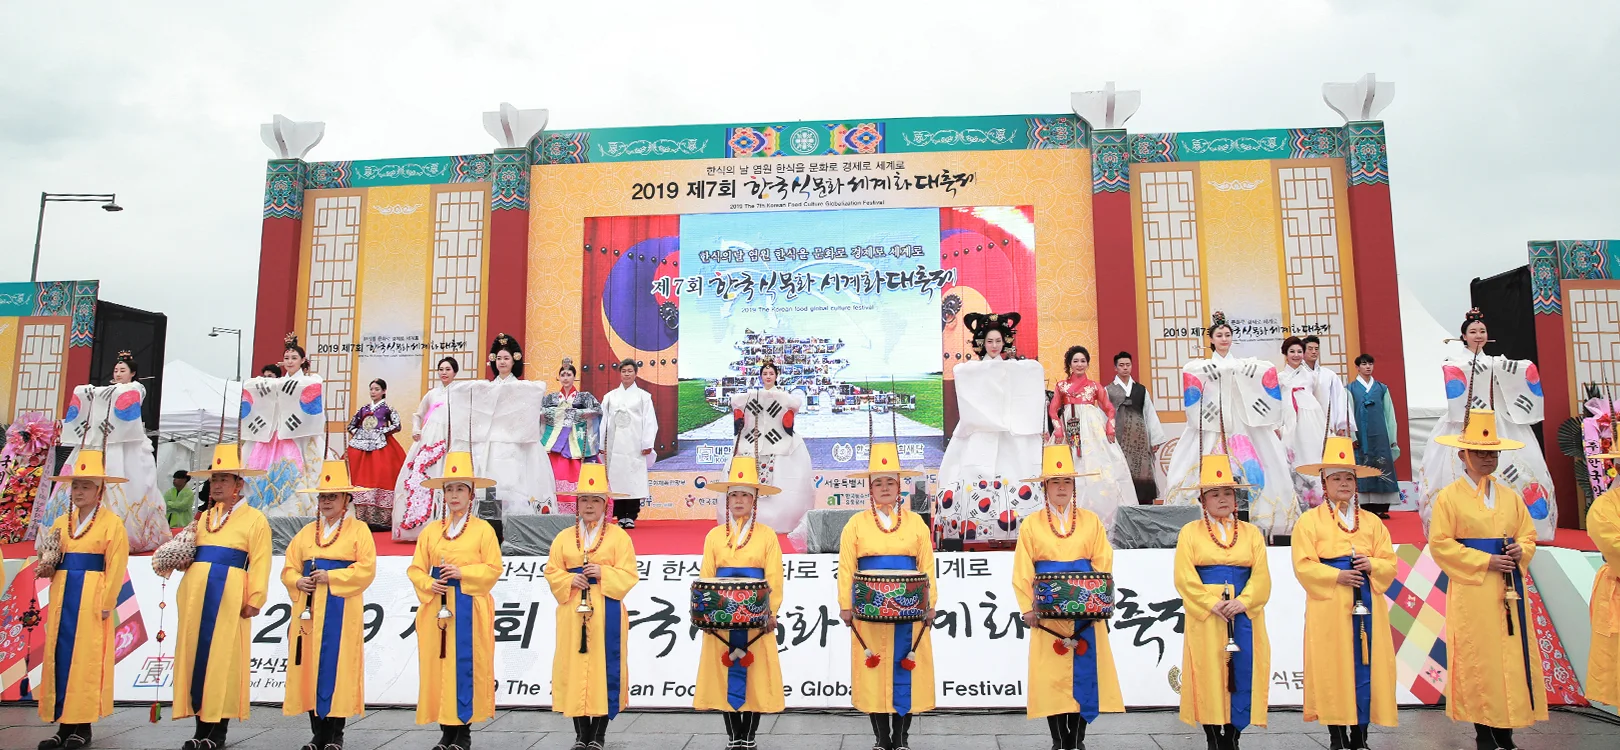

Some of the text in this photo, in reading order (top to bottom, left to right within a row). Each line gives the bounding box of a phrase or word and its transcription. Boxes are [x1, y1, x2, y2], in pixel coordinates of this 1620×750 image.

[706, 160, 905, 176] 한식의 날 염원 한식을 문화로 경제로 세계로
[632, 182, 679, 200] 2019
[687, 180, 736, 199] 제7회
[748, 248, 770, 261] 염원
[774, 247, 809, 261] 한식을
[812, 247, 848, 260] 문화로
[851, 245, 886, 259] 경제로
[888, 245, 925, 258] 세계로
[810, 305, 828, 313] global
[1163, 328, 1187, 337] 2019
[318, 344, 339, 353] 2019
[341, 343, 363, 353] 제7회
[825, 478, 865, 488] 서울특별시
[506, 680, 541, 695] The
[942, 681, 1022, 696] Festival
